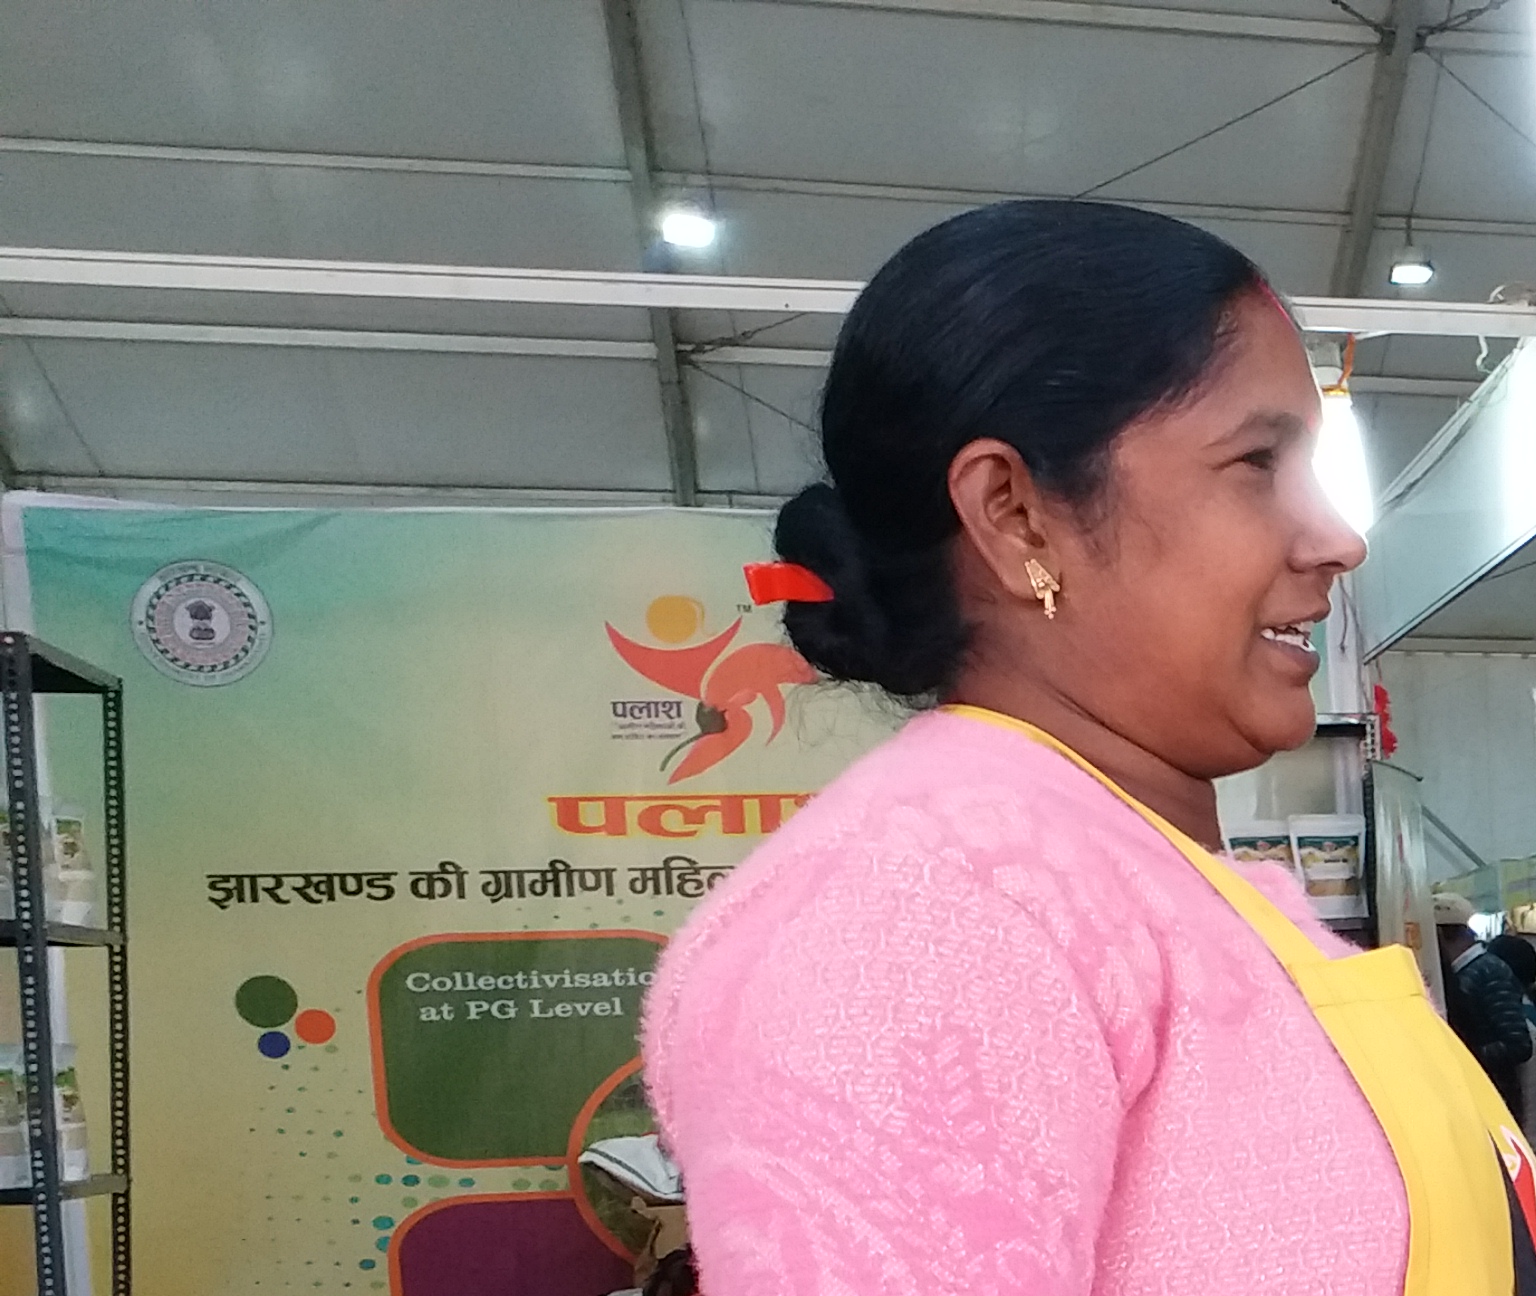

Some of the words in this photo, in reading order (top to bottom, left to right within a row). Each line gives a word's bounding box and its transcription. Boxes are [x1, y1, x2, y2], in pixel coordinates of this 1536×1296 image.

[610, 699, 684, 720] पलाश
[546, 792, 812, 838] पला
[206, 871, 398, 910] झारखण्ड
[409, 860, 468, 901] की
[479, 858, 617, 904] ग्रामीण
[419, 1003, 455, 1022] at
[466, 1000, 518, 1020] PG
[529, 997, 624, 1019] Level
